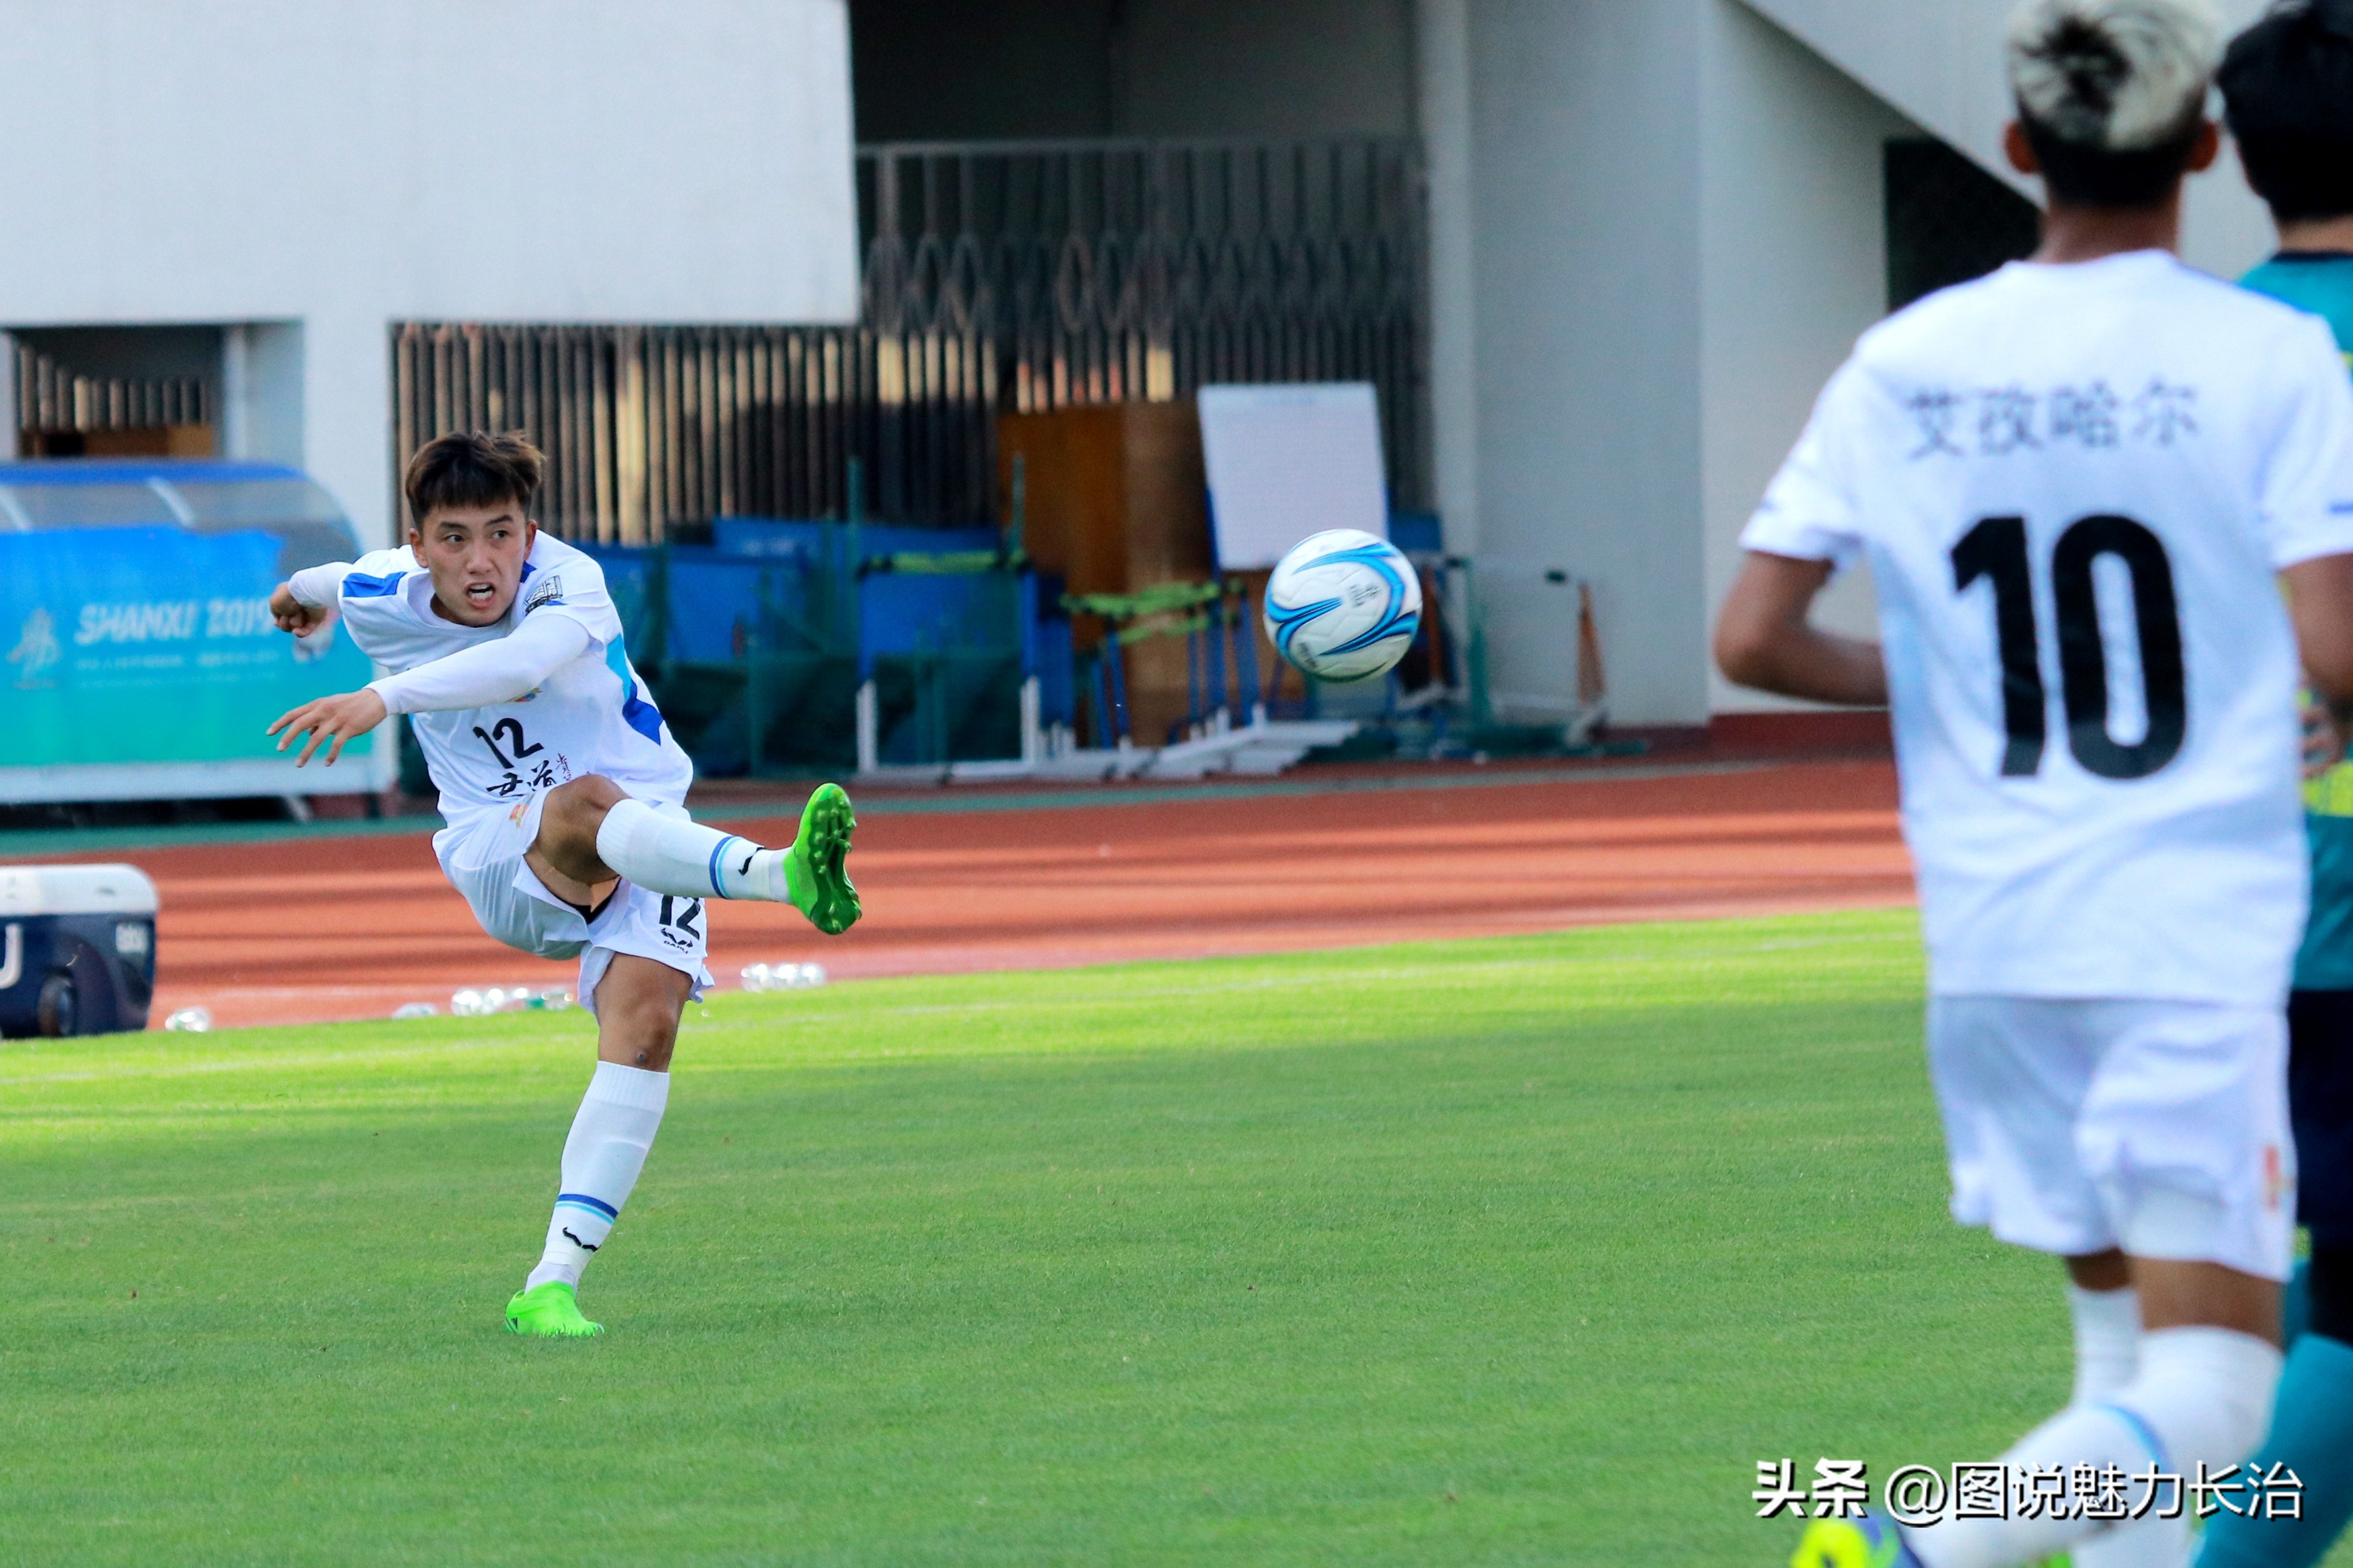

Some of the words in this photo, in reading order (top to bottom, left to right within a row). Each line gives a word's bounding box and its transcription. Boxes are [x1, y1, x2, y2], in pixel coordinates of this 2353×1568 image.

[74, 601, 199, 645] SHANXI
[1950, 514, 2187, 780] 10
[473, 718, 544, 769] 12
[659, 896, 700, 941] 12
